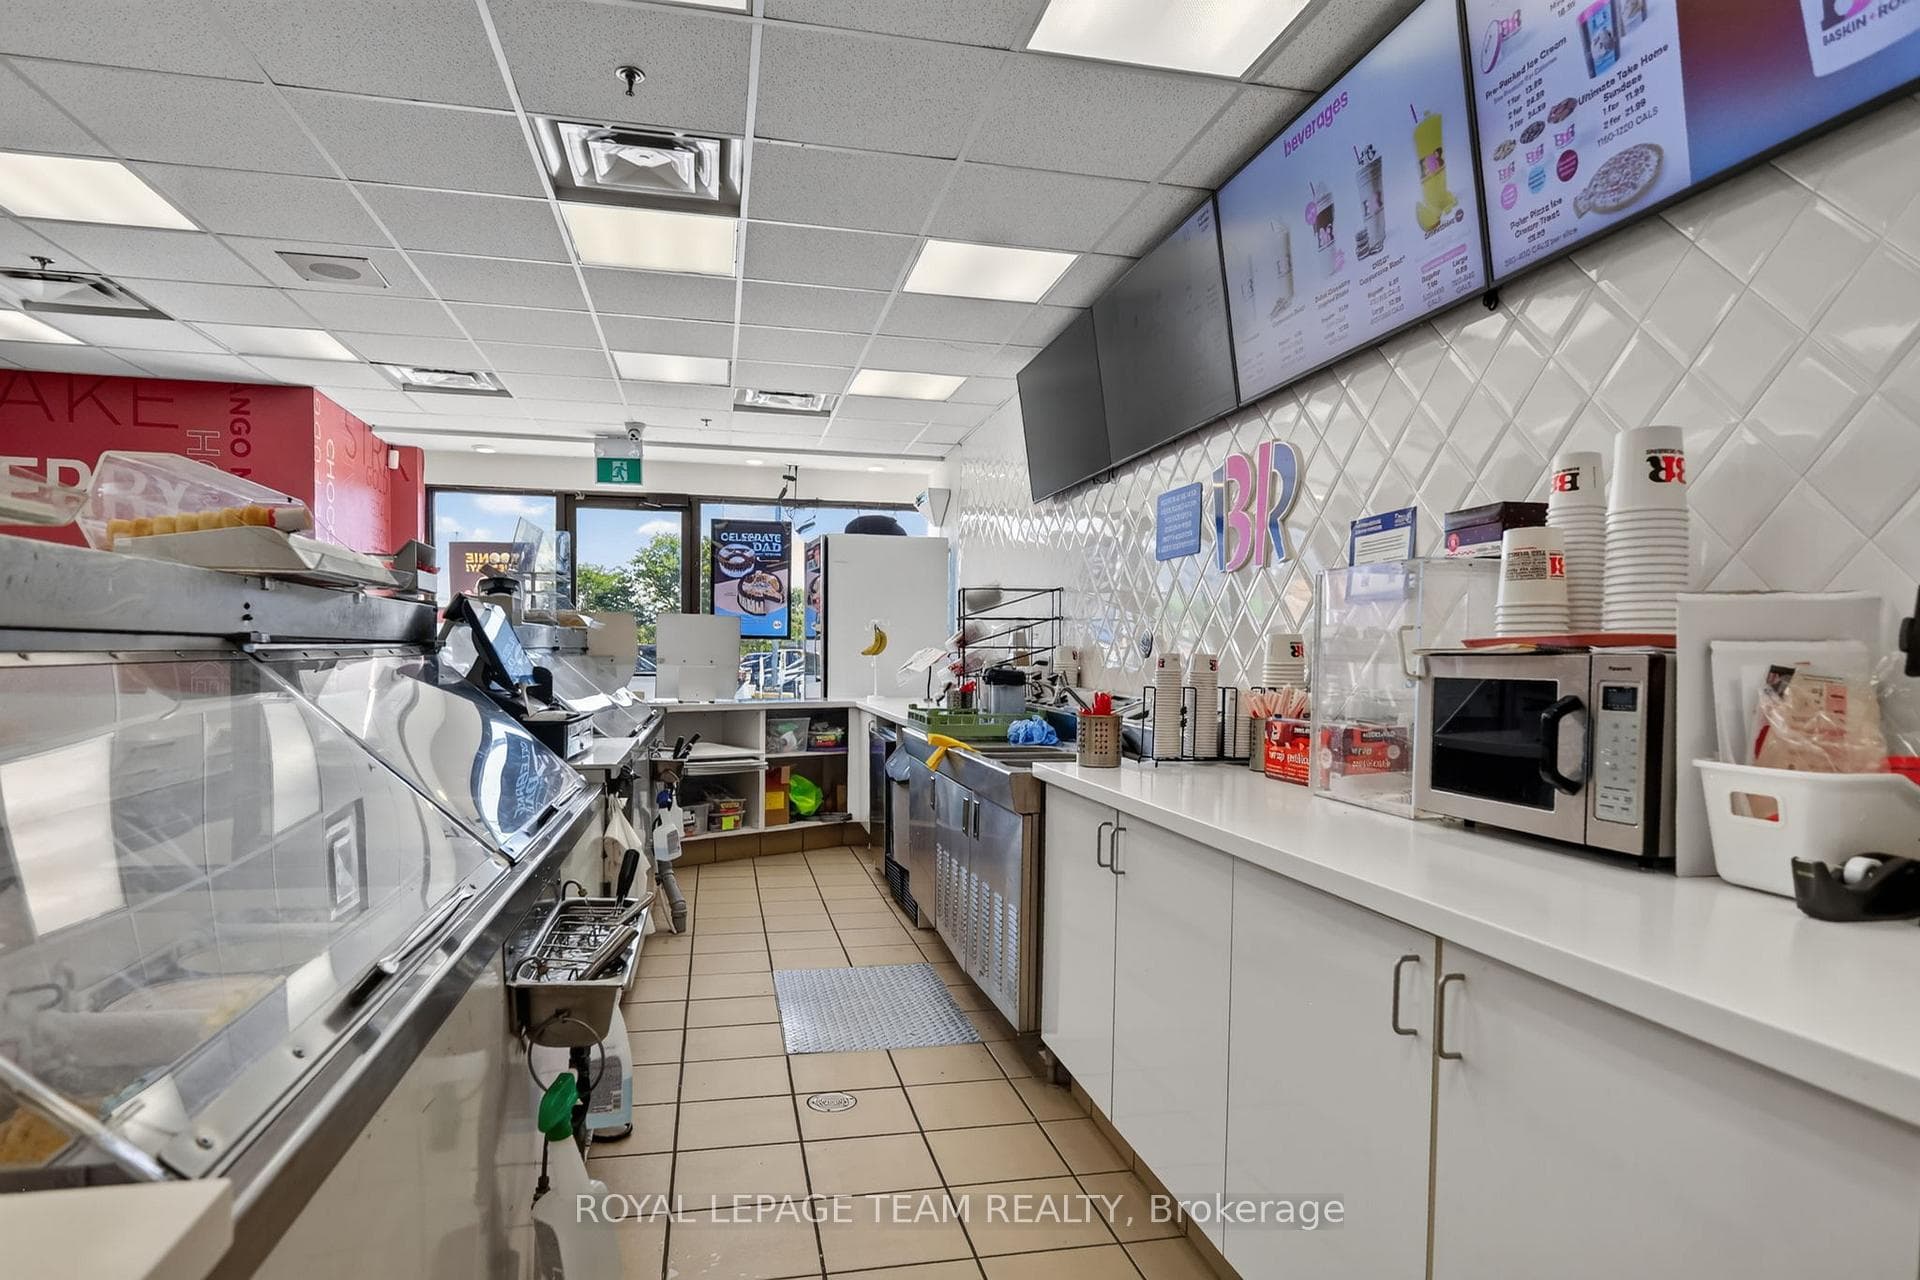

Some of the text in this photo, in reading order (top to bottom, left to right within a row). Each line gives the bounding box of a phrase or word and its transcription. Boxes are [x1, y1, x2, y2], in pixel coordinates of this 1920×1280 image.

[1822, 14, 1868, 46] BASKIN
[1616, 63, 1639, 80] Take
[1640, 44, 1669, 66] Home
[1283, 91, 1349, 158] beverages
[1635, 106, 1659, 125] CALS
[720, 532, 782, 543] CELEBRATE
[752, 542, 782, 552] DAD
